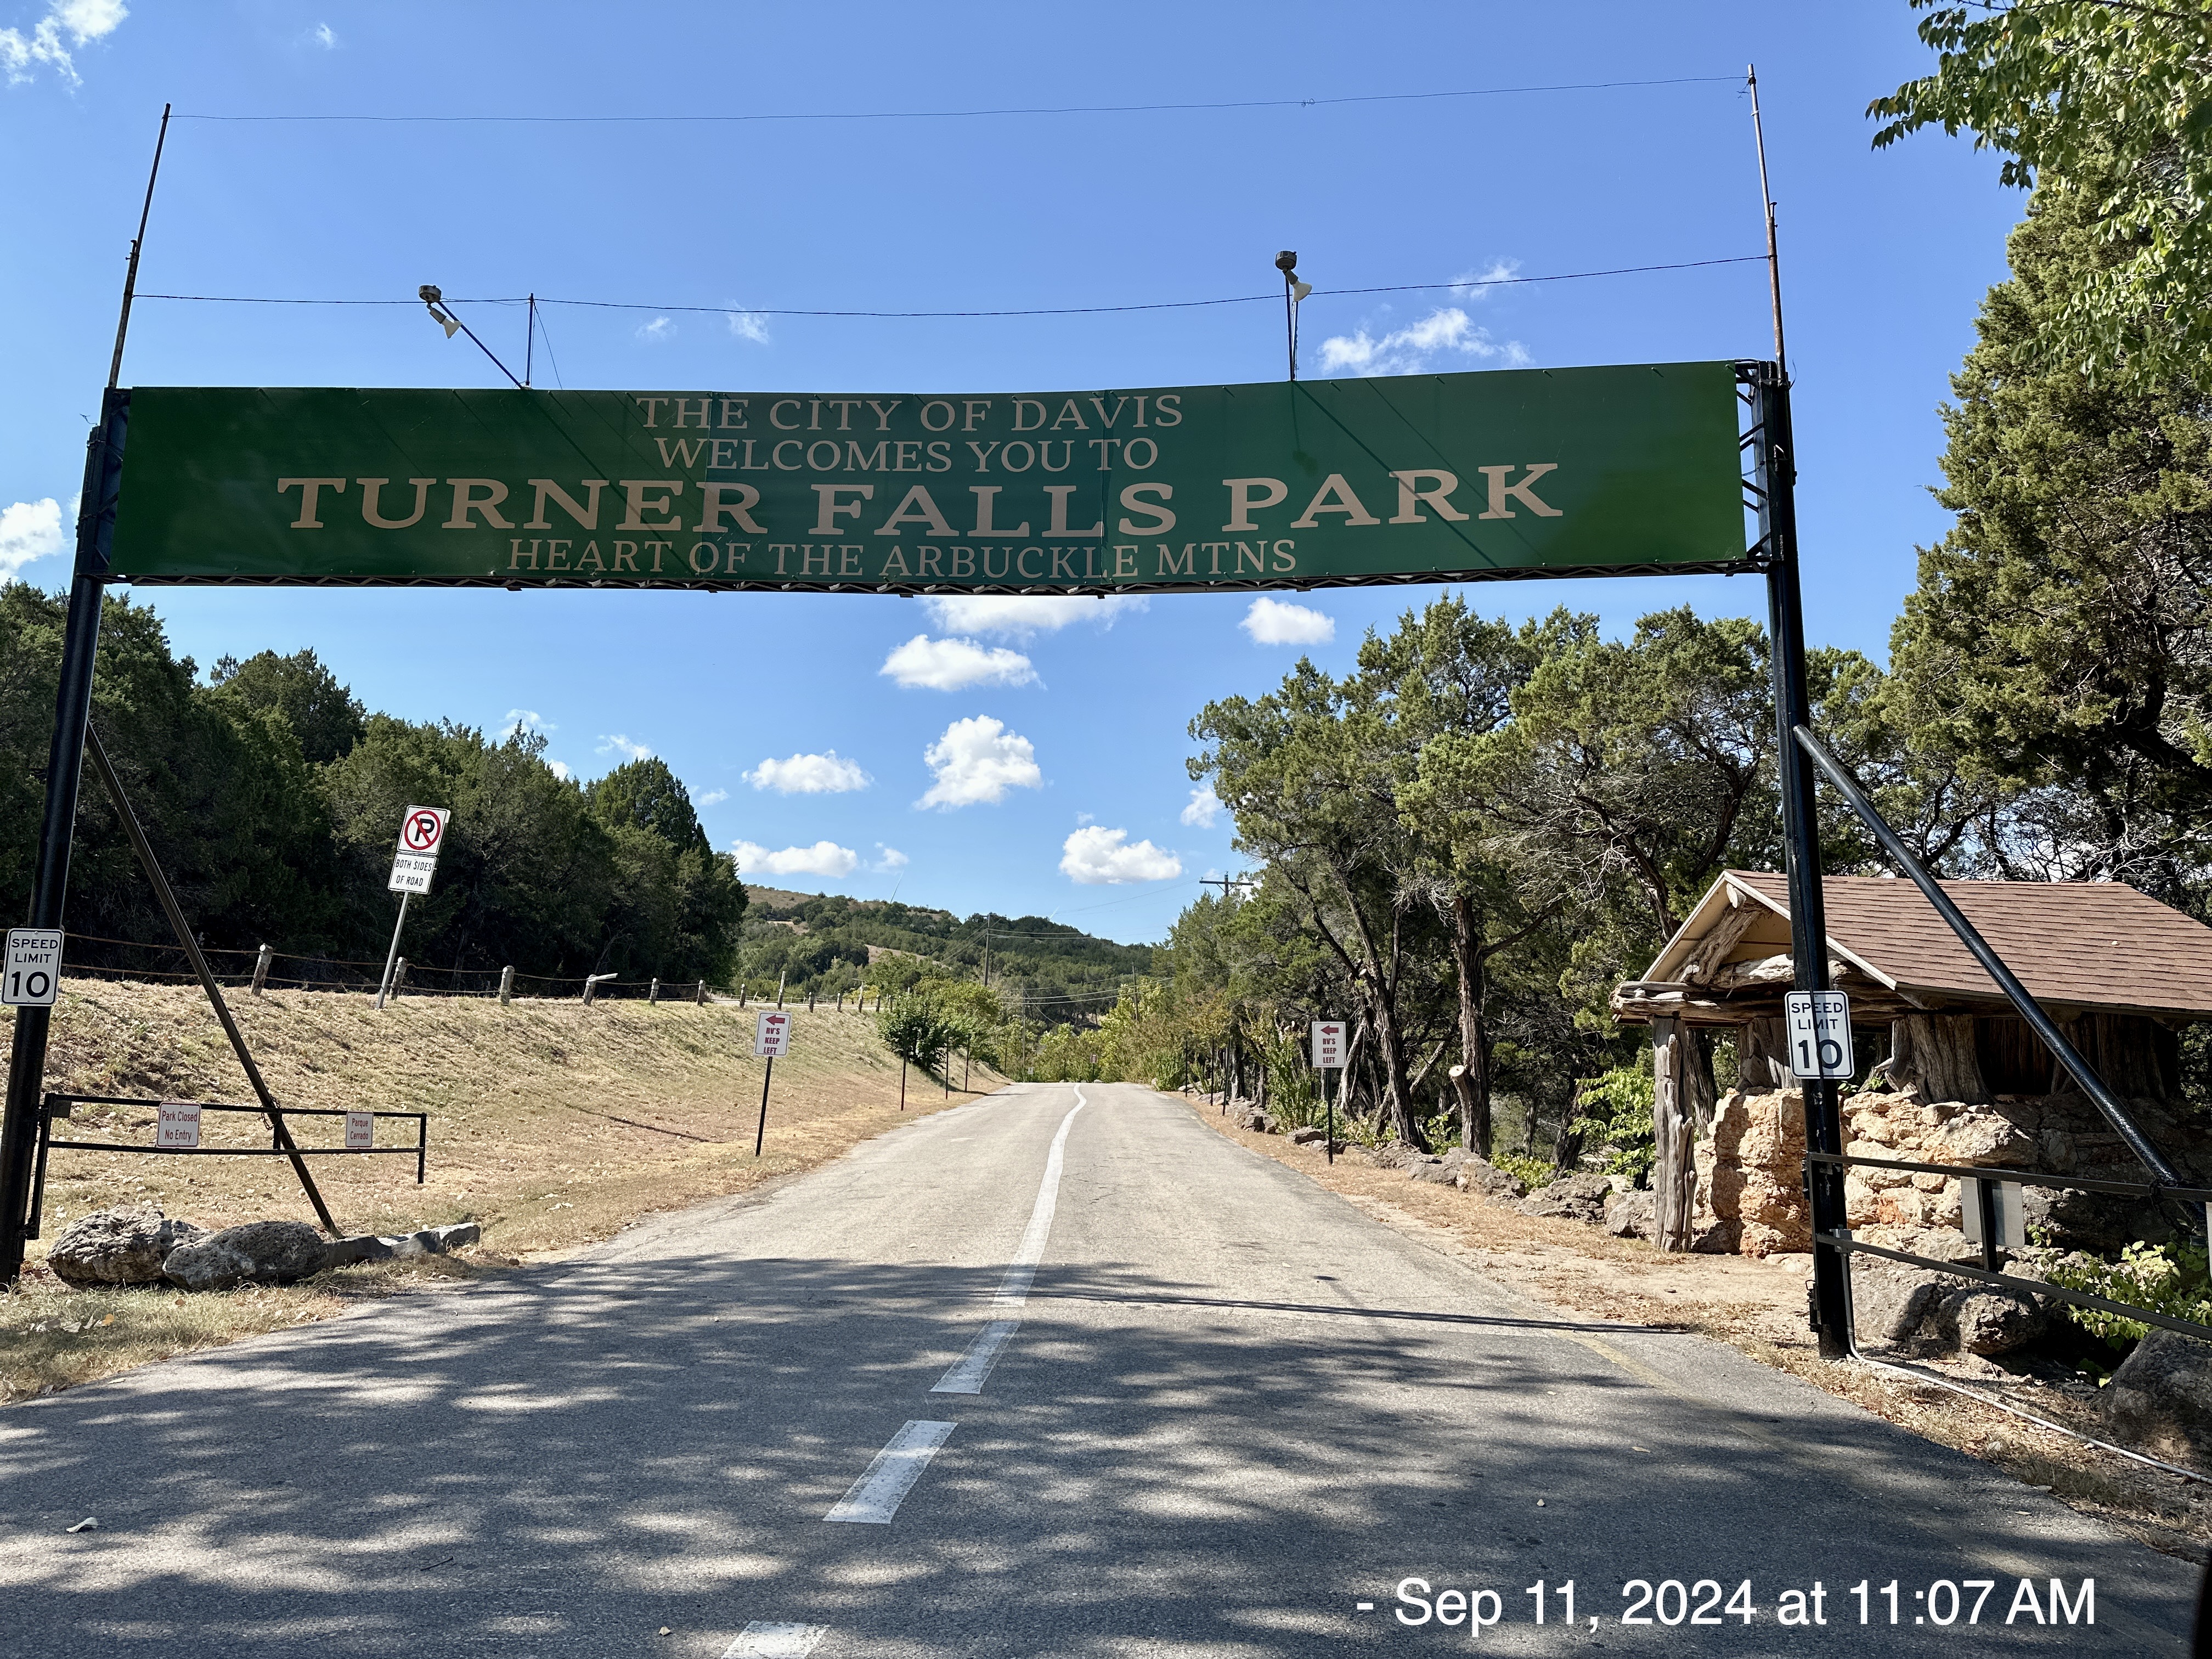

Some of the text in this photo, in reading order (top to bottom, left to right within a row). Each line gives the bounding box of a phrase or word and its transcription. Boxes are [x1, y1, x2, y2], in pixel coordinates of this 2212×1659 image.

[636, 395, 1182, 432] THE CITY OF DAVIS
[655, 437, 1158, 472] WELCOMES YOU TO
[277, 462, 1564, 538] TURNER FALLS PARK
[506, 538, 1297, 579] HEART OF THE ARBUCKLE MTNS
[396, 859, 432, 872] BOTH SIDES
[396, 875, 423, 887] OF ROAD
[12, 939, 58, 949] SPEED
[15, 953, 52, 963] LIMIT
[11, 971, 50, 997] 10
[1791, 1002, 1843, 1013] SPEED
[1798, 1019, 1838, 1029] LIMIT
[1798, 1039, 1843, 1069] 10
[162, 1110, 198, 1122] Park Closed
[352, 1118, 368, 1128] Parque
[165, 1129, 192, 1142] No Entry
[350, 1131, 369, 1140] Cerrado
